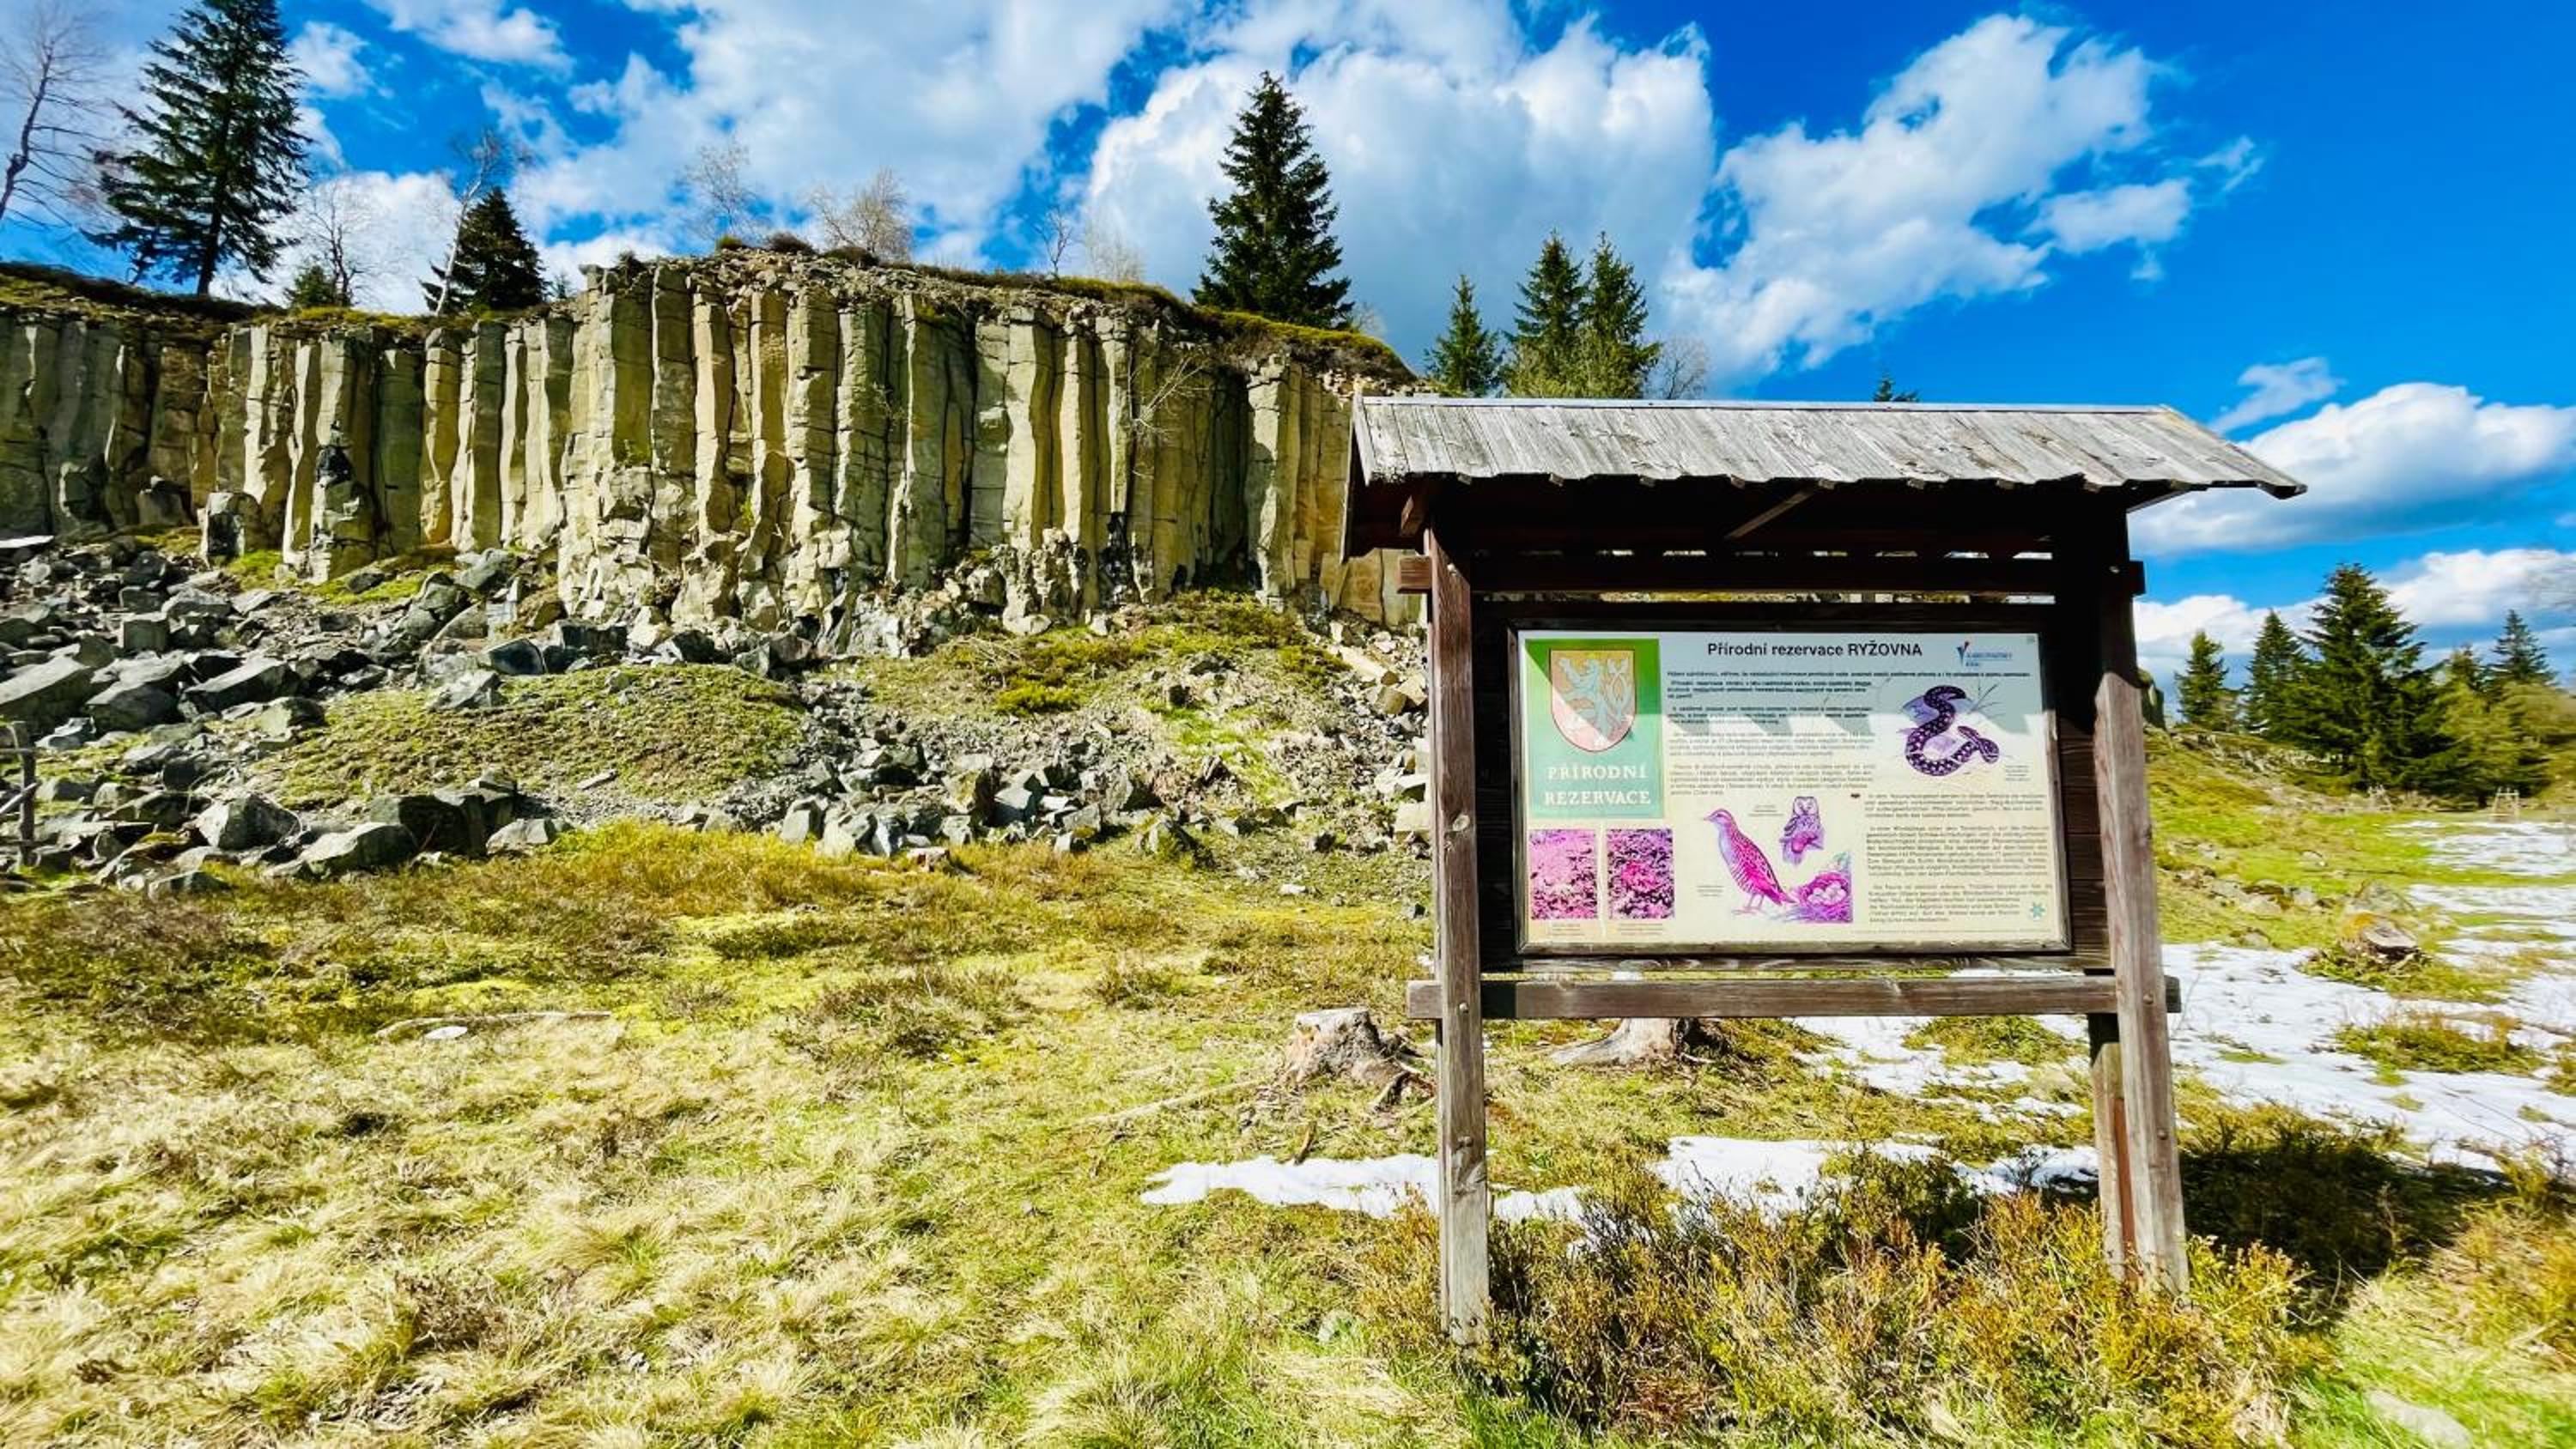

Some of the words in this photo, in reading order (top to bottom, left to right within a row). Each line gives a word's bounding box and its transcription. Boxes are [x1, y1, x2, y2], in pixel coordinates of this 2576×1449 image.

[1708, 642, 1767, 656] Přírodní
[1771, 646, 1843, 656] rezervace
[1848, 640, 1923, 656] RYŽOVNA
[1545, 791, 1650, 805] REZERVACE
